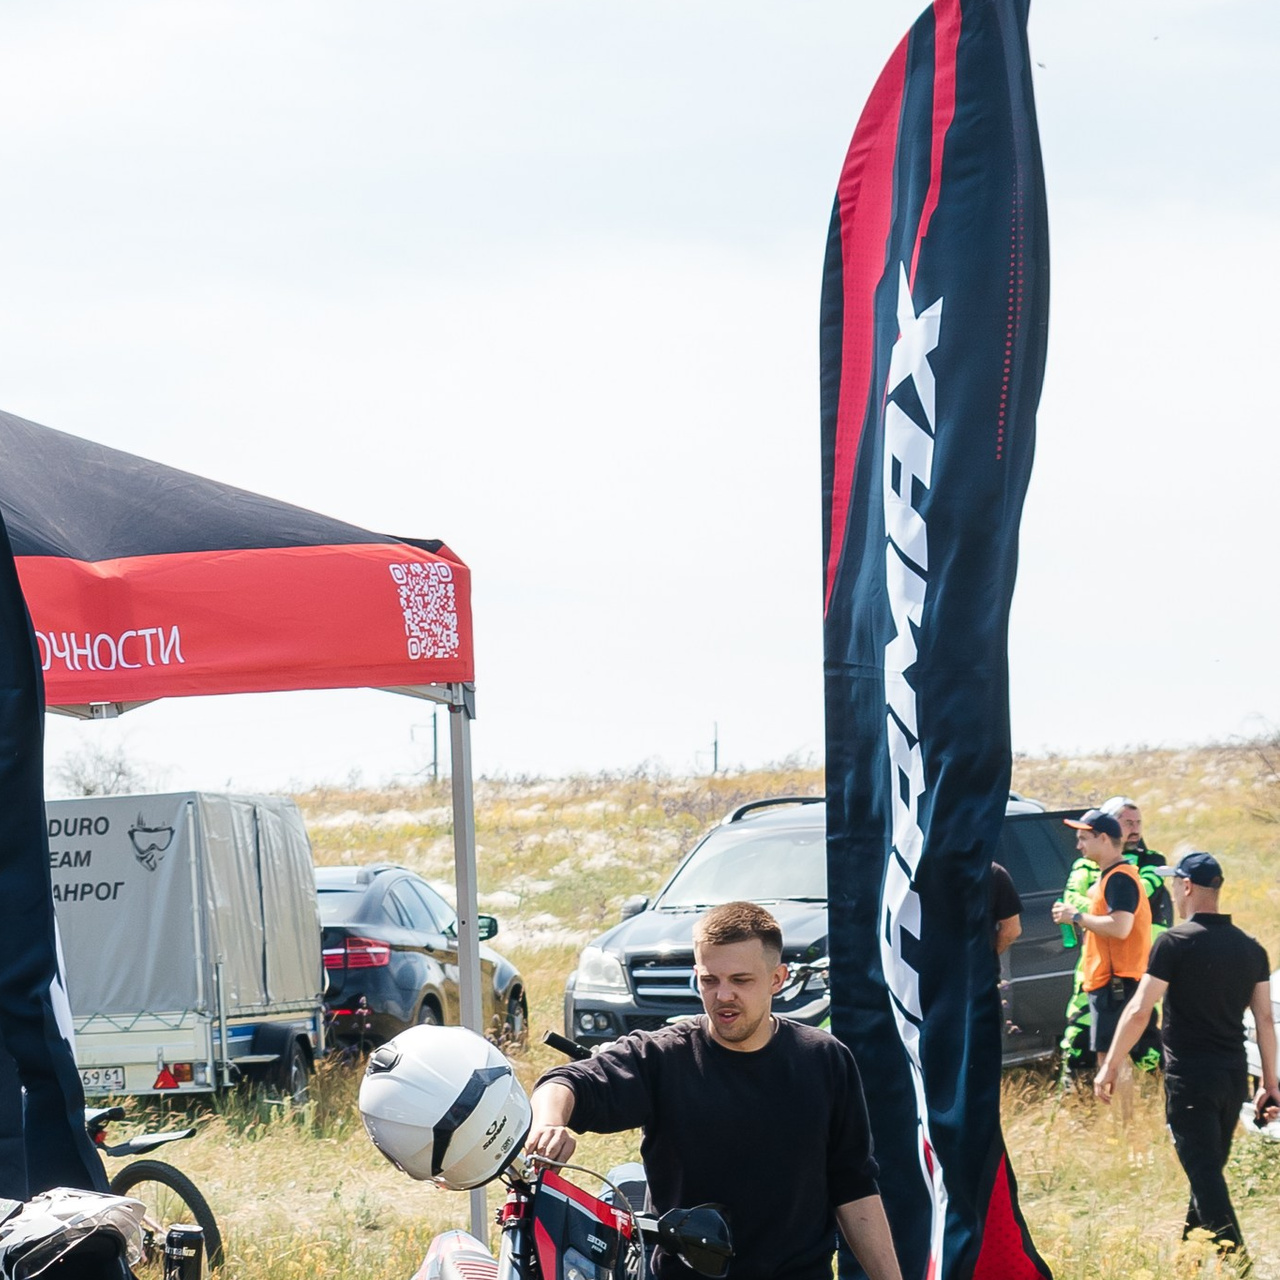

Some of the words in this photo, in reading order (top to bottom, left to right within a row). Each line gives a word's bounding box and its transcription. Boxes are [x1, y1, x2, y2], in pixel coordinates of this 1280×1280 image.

[35, 625, 185, 671] ОЧНОСТИ
[48, 816, 110, 838] DURO
[49, 850, 92, 869] EAM
[53, 881, 125, 902] АНРОГ
[82, 1071, 100, 1085] 69
